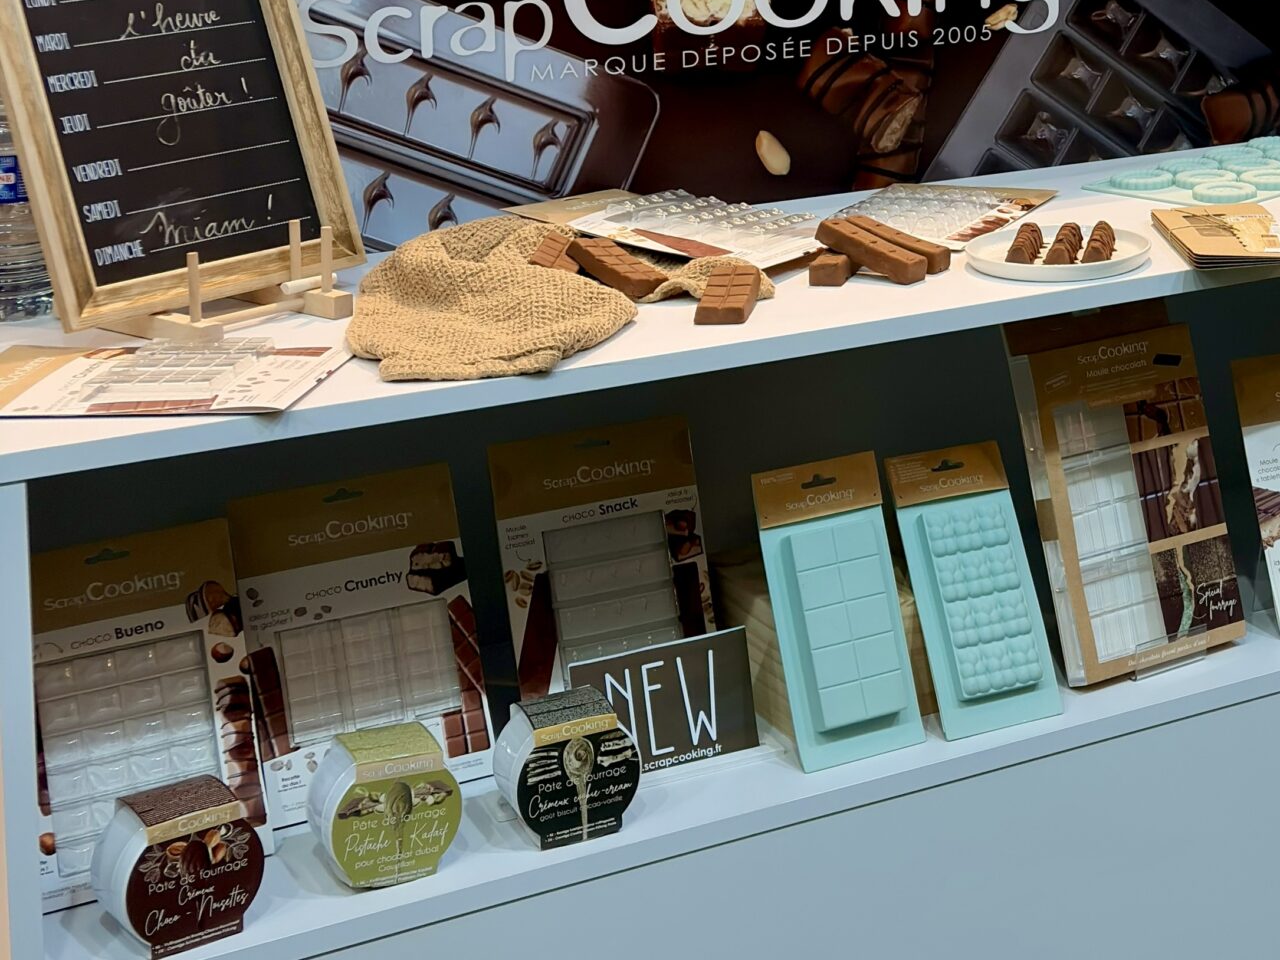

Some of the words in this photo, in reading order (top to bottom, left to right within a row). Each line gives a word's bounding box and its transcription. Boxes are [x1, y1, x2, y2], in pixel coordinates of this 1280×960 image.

[118, 2, 221, 40] l'heure
[35, 32, 71, 52] MARDI
[531, 50, 668, 82] MARQUE
[681, 35, 813, 71] DÉPOSÉE
[825, 27, 920, 57] DEPUIS
[932, 23, 993, 48] 2005
[180, 40, 221, 71] du
[47, 70, 98, 93] MERCREDI
[61, 113, 91, 135] JEUDI
[156, 86, 232, 146] goûter
[73, 159, 123, 183] VENDREDI
[83, 200, 120, 222] SAMEDI
[94, 240, 144, 266] DIMANCHE
[1086, 367, 1109, 378] Moule
[1259, 458, 1279, 466] Moule
[562, 510, 596, 523] CHOCO
[599, 498, 638, 516] Snack
[305, 586, 342, 601] CHOCO
[344, 571, 403, 593] Crunchy
[70, 633, 112, 651] CHOCO
[114, 618, 165, 640] Bueno
[604, 649, 718, 756] NEW
[642, 745, 722, 772] .scrapcooking.fr
[538, 781, 562, 794] Pâte
[529, 794, 569, 819] Crémeux
[540, 811, 555, 822] goût
[557, 805, 577, 818] biscuit
[353, 818, 380, 830] Pâte
[382, 816, 396, 825] de
[344, 831, 390, 862] Pistache
[409, 820, 449, 849] Kadaïf
[148, 880, 176, 895] Pâte
[180, 873, 196, 886] de
[199, 857, 249, 879] fourrage
[355, 858, 375, 870] pour
[145, 909, 180, 937] Choco
[197, 885, 249, 922] Noisettes
